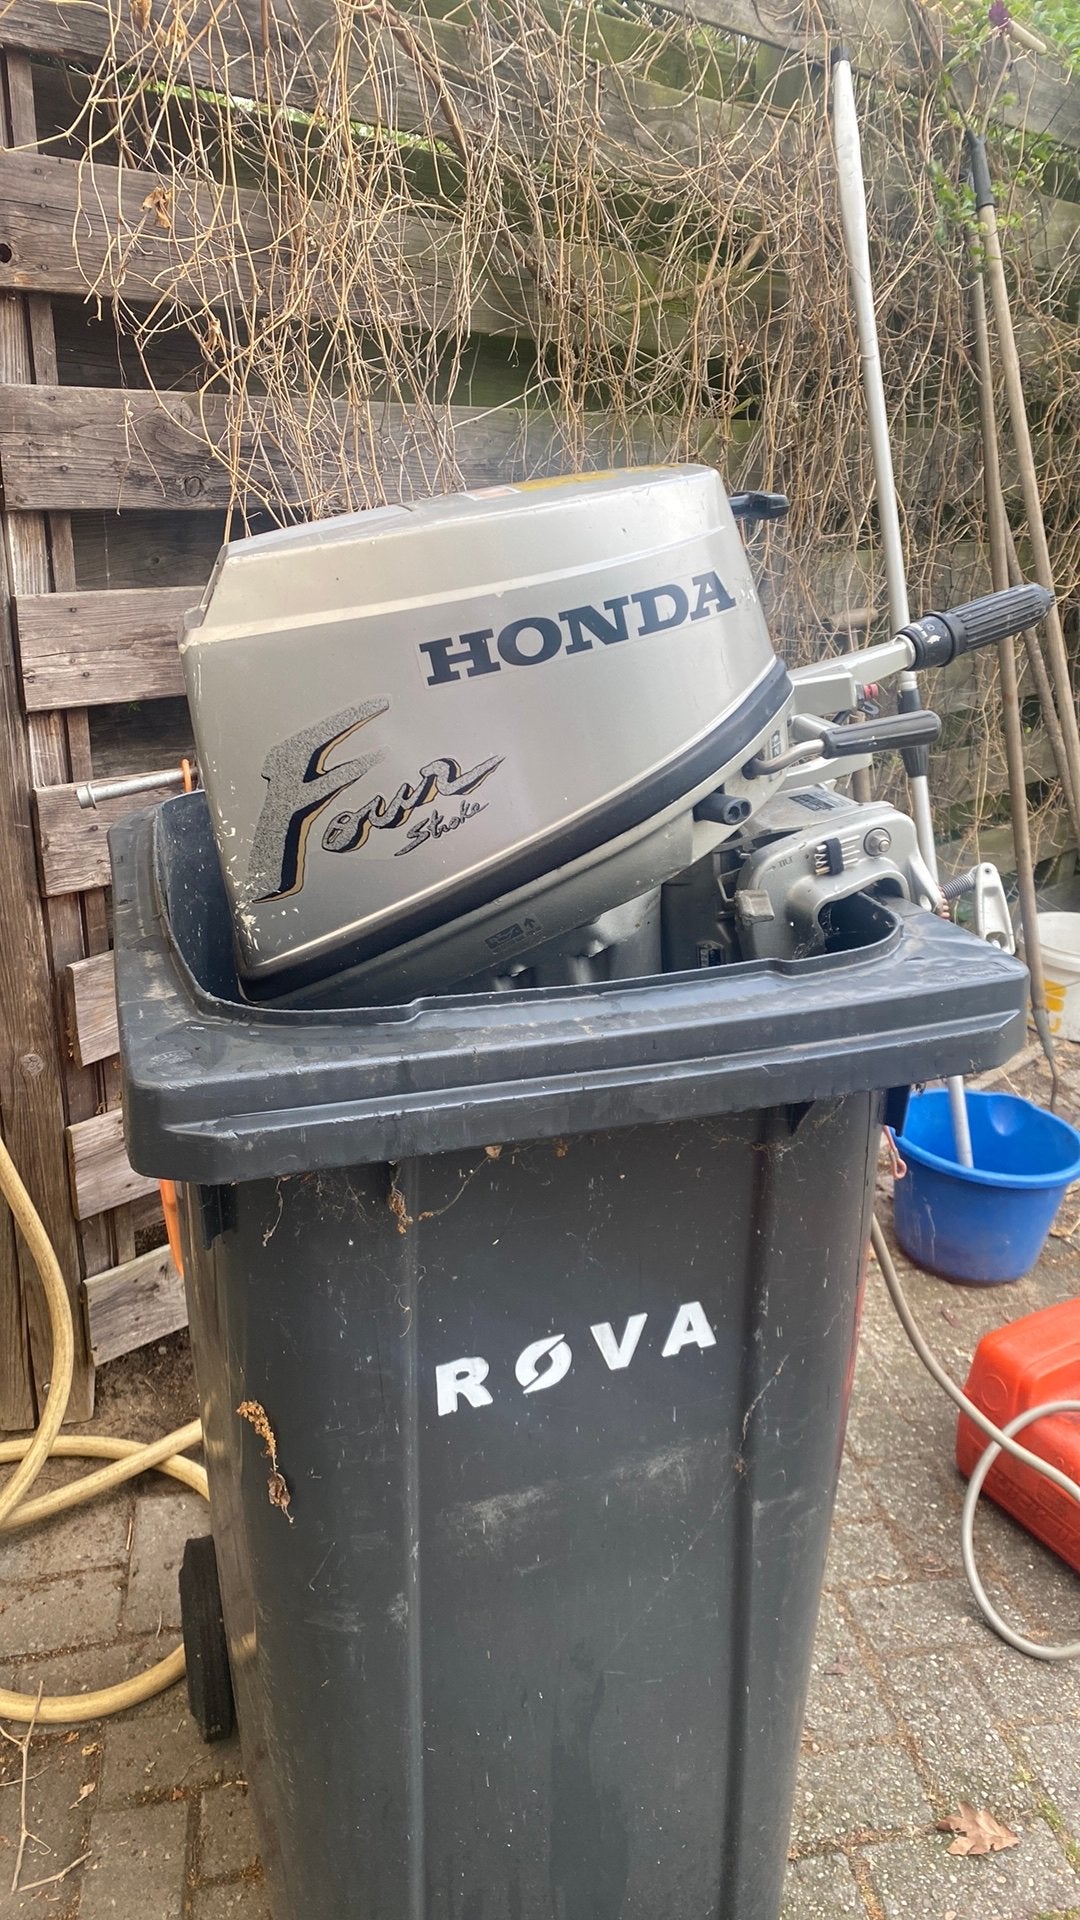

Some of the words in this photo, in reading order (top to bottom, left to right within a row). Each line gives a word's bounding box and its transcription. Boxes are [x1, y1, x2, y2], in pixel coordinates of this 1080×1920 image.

[419, 571, 737, 686] HONDA
[249, 697, 506, 904] Four
[394, 799, 490, 857] Stroke
